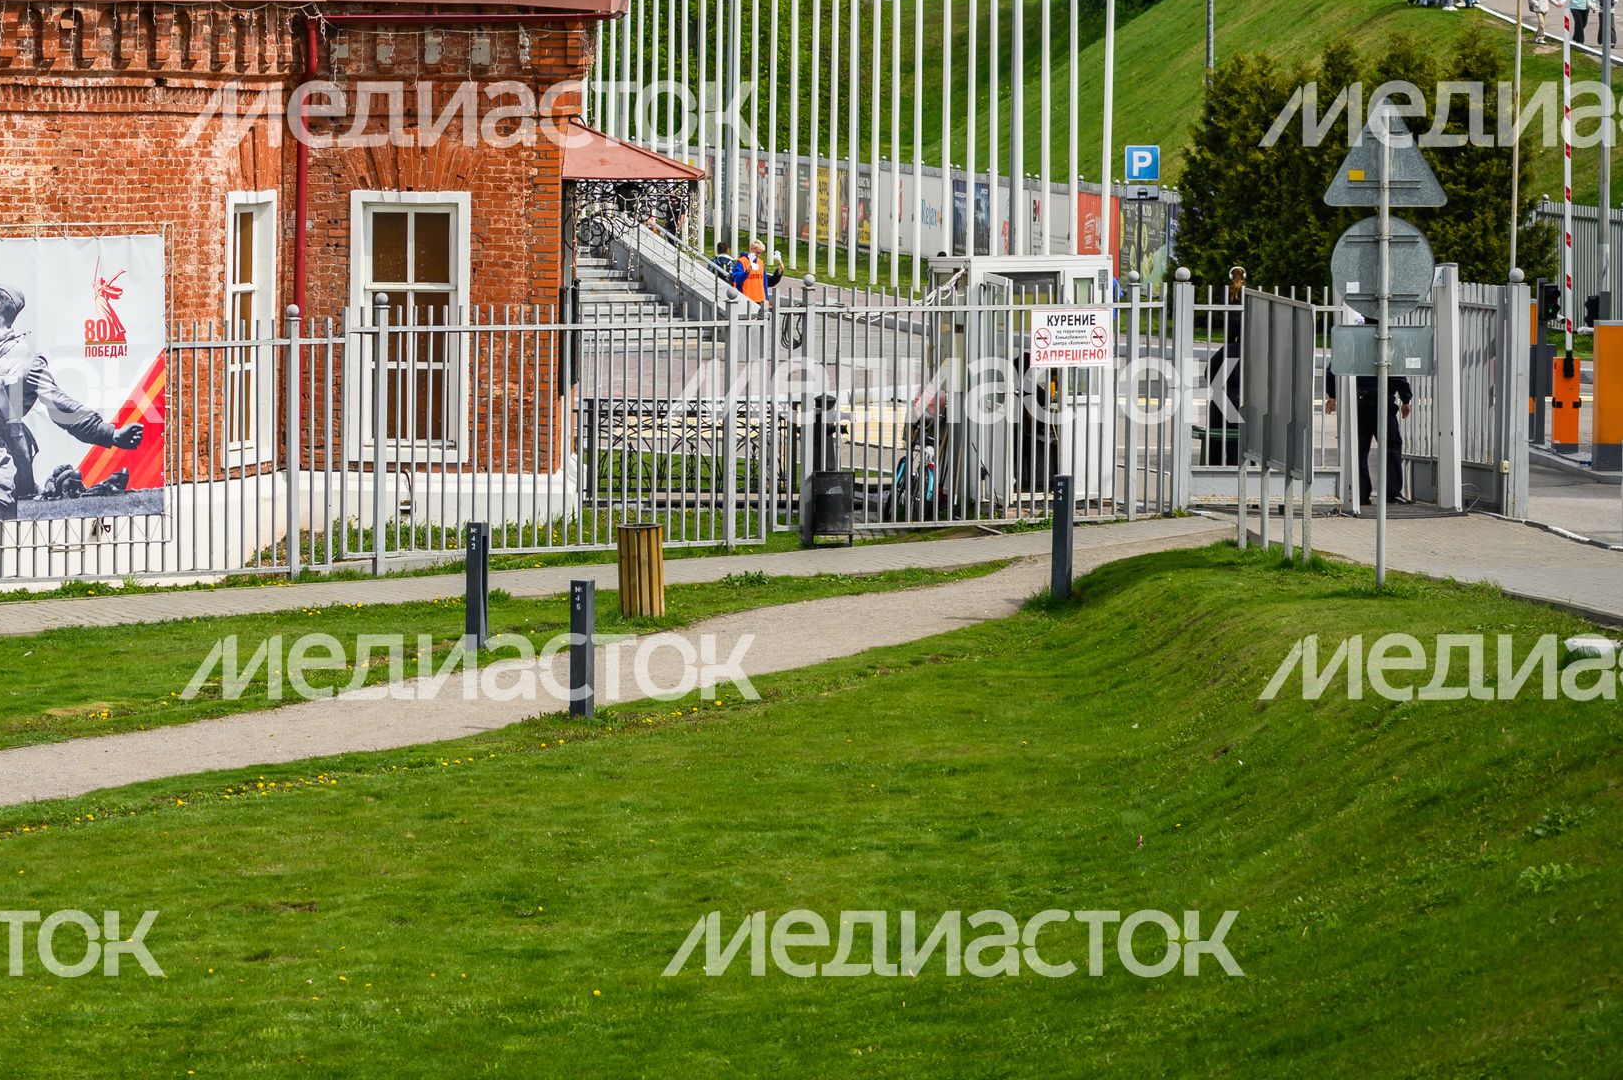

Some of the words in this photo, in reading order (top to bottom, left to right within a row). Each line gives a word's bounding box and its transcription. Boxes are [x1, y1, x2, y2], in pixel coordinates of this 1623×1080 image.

[1047, 314, 1096, 326] КУРЕНИЕ
[85, 319, 107, 342] 80
[85, 345, 128, 358] ПОБЕДА!
[1035, 349, 1107, 363] ЗАПРЕЩЕНО!
